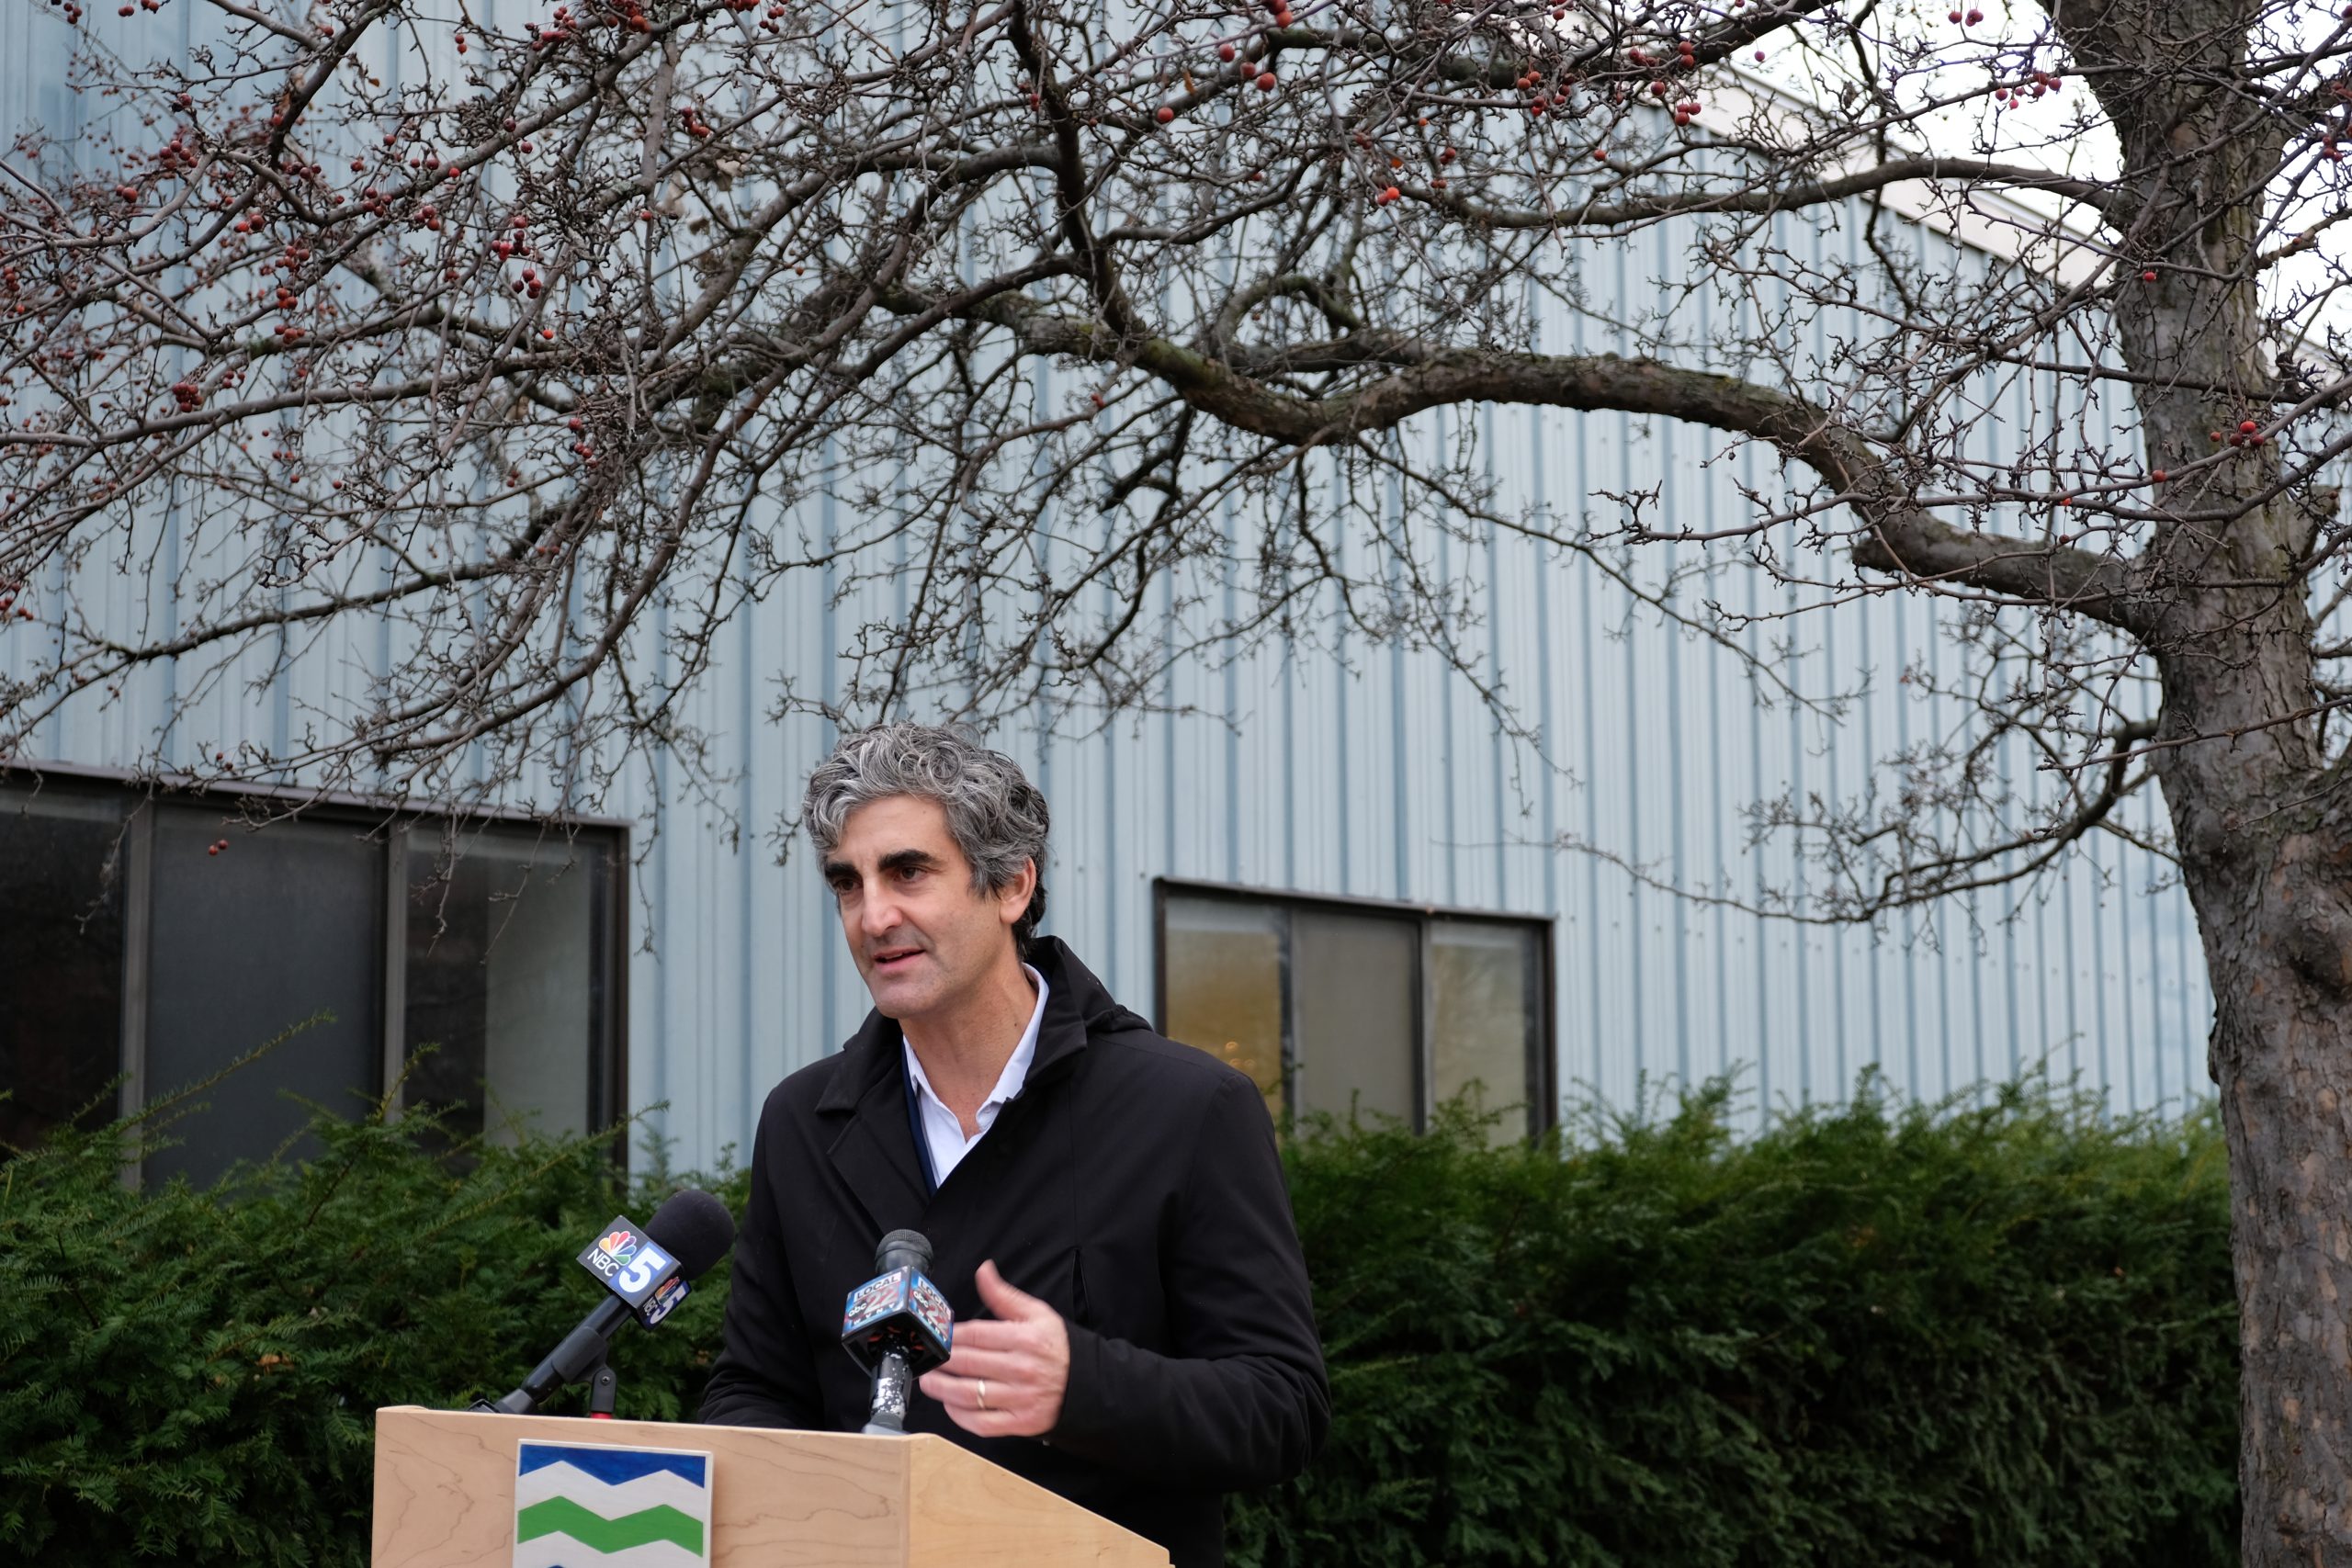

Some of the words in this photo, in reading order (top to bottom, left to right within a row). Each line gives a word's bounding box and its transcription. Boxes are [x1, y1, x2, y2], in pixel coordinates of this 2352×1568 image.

[587, 1247, 619, 1277] NBC
[618, 1247, 666, 1293] 5
[848, 1302, 867, 1317] abc
[863, 1284, 898, 1314] 22
[856, 1276, 899, 1299] LOCAL
[912, 1291, 929, 1308] abc
[921, 1280, 951, 1316] LOCAL
[642, 1296, 658, 1316] NBC
[650, 1284, 686, 1325] 5
[854, 1303, 895, 1325] WVNY
